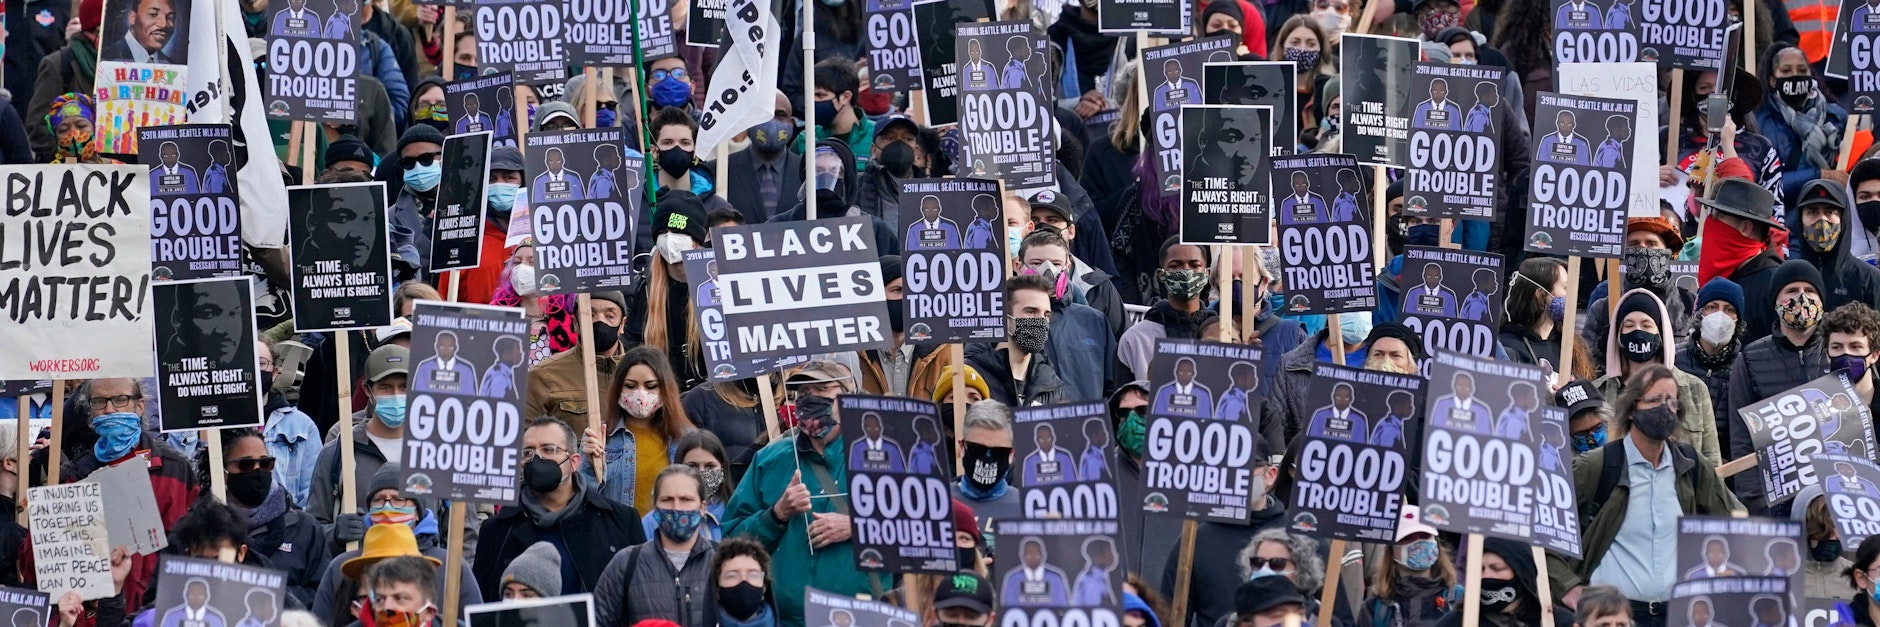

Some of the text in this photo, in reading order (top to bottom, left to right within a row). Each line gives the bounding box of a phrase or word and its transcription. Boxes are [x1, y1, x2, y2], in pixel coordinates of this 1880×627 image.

[476, 4, 560, 42] GOOD
[1641, 0, 1726, 29] GOOD
[1557, 31, 1637, 62] GOOD
[1640, 22, 1724, 50] TROUBLE
[269, 37, 357, 79] GOOD
[478, 38, 563, 64] TROUBLE
[115, 68, 178, 85] HAPPY
[1430, 66, 1449, 76] ANNUAL
[1449, 68, 1471, 77] SEATTLE
[1472, 69, 1483, 78] MLK
[1490, 71, 1499, 81] DAY
[1571, 77, 1600, 92] LAS
[1613, 75, 1655, 93] VIDAS
[269, 74, 356, 101] TROUBLE
[1783, 80, 1808, 96] GLAM
[965, 91, 1036, 131] GOOD
[1362, 101, 1383, 114] TIME
[1556, 97, 1577, 108] ANNUAL
[1578, 99, 1602, 110] SEATTLE
[1602, 102, 1614, 111] MLK
[1622, 105, 1632, 114] DAY
[1350, 113, 1408, 129] ALWAYS RIGHT
[1357, 126, 1367, 135] DO
[1367, 127, 1385, 136] WHAT
[1386, 129, 1393, 137] IS
[543, 135, 563, 145] ANNUAL
[563, 133, 587, 144] SEATTLE
[587, 132, 599, 142] MLK
[608, 132, 617, 141] DAY
[969, 129, 1040, 155] TROUBLE
[993, 152, 1041, 164] NECESSARY TROUBLE
[1409, 130, 1496, 174] GOOD
[919, 183, 940, 192] ANNUAL
[941, 182, 965, 192] SEATTLE
[966, 182, 978, 191] MLK
[987, 182, 997, 192] DAY
[1204, 177, 1228, 190] TIME
[1408, 168, 1494, 197] TROUBLE
[1532, 163, 1628, 211] GOOD
[6, 170, 136, 218] BLACK
[1191, 191, 1266, 203] ALWAYS RIGHT TO
[150, 196, 238, 237] GOOD
[447, 204, 460, 216] TIME
[1199, 203, 1209, 213] DO
[1210, 204, 1230, 213] WHAT
[1231, 204, 1239, 213] IS
[1531, 203, 1625, 234] TROUBLE
[438, 215, 476, 230] ALWAYS RIGHT
[533, 201, 626, 244] GOOD
[0, 220, 117, 271] LIVES
[721, 223, 867, 261] BLACK
[1281, 224, 1369, 266] GOOD
[1569, 231, 1623, 244] NECESSARY TROUBLE
[150, 235, 241, 263] TROUBLE
[535, 240, 629, 270] TROUBLE
[1423, 250, 1444, 261] ANNUAL
[1444, 252, 1469, 263] SEATTLE
[1469, 254, 1482, 264] MLK
[1489, 257, 1499, 267] DAY
[315, 260, 342, 274] TIME
[343, 264, 349, 272] IS
[576, 265, 629, 277] NECESSARY TROUBLE
[906, 252, 1001, 293] GOOD
[1285, 262, 1373, 290] TROUBLE
[302, 272, 384, 288] ALWAYS RIGHT TO
[730, 269, 874, 307] LIVES
[311, 288, 322, 299] DO
[323, 287, 345, 298] WHAT
[347, 287, 355, 297] IS
[1324, 287, 1374, 298] NECESSARY TROUBLE
[907, 292, 1003, 318] TROUBLE
[949, 317, 1003, 327] NECESSARY TROUBLE
[737, 315, 884, 354] MATTER
[1629, 342, 1650, 353] BLM
[181, 357, 208, 371] TIME
[209, 361, 216, 369] IS
[169, 369, 252, 386] ALWAYS RIGHT TO
[177, 386, 189, 397] DO
[189, 385, 212, 396] WHAT
[214, 384, 222, 395] IS
[408, 393, 521, 448] GOOD
[1146, 416, 1254, 469] GOOD
[406, 440, 518, 476] TROUBLE
[1299, 438, 1408, 494] GOOD
[1425, 428, 1536, 488] GOOD
[1145, 460, 1250, 496] TROUBLE
[29, 484, 99, 501] IF INJUSTICE
[850, 473, 950, 521] GOOD
[1295, 481, 1401, 519] TROUBLE
[1424, 472, 1533, 514] TROUBLE
[29, 501, 99, 516] CAN BRING US
[34, 515, 96, 529] TOGETHER
[854, 517, 954, 548] TROUBLE
[33, 532, 59, 545] LIKE
[38, 545, 92, 559] IMAGINE
[37, 559, 110, 575] WHAT PEACE
[40, 578, 63, 590] CAN
